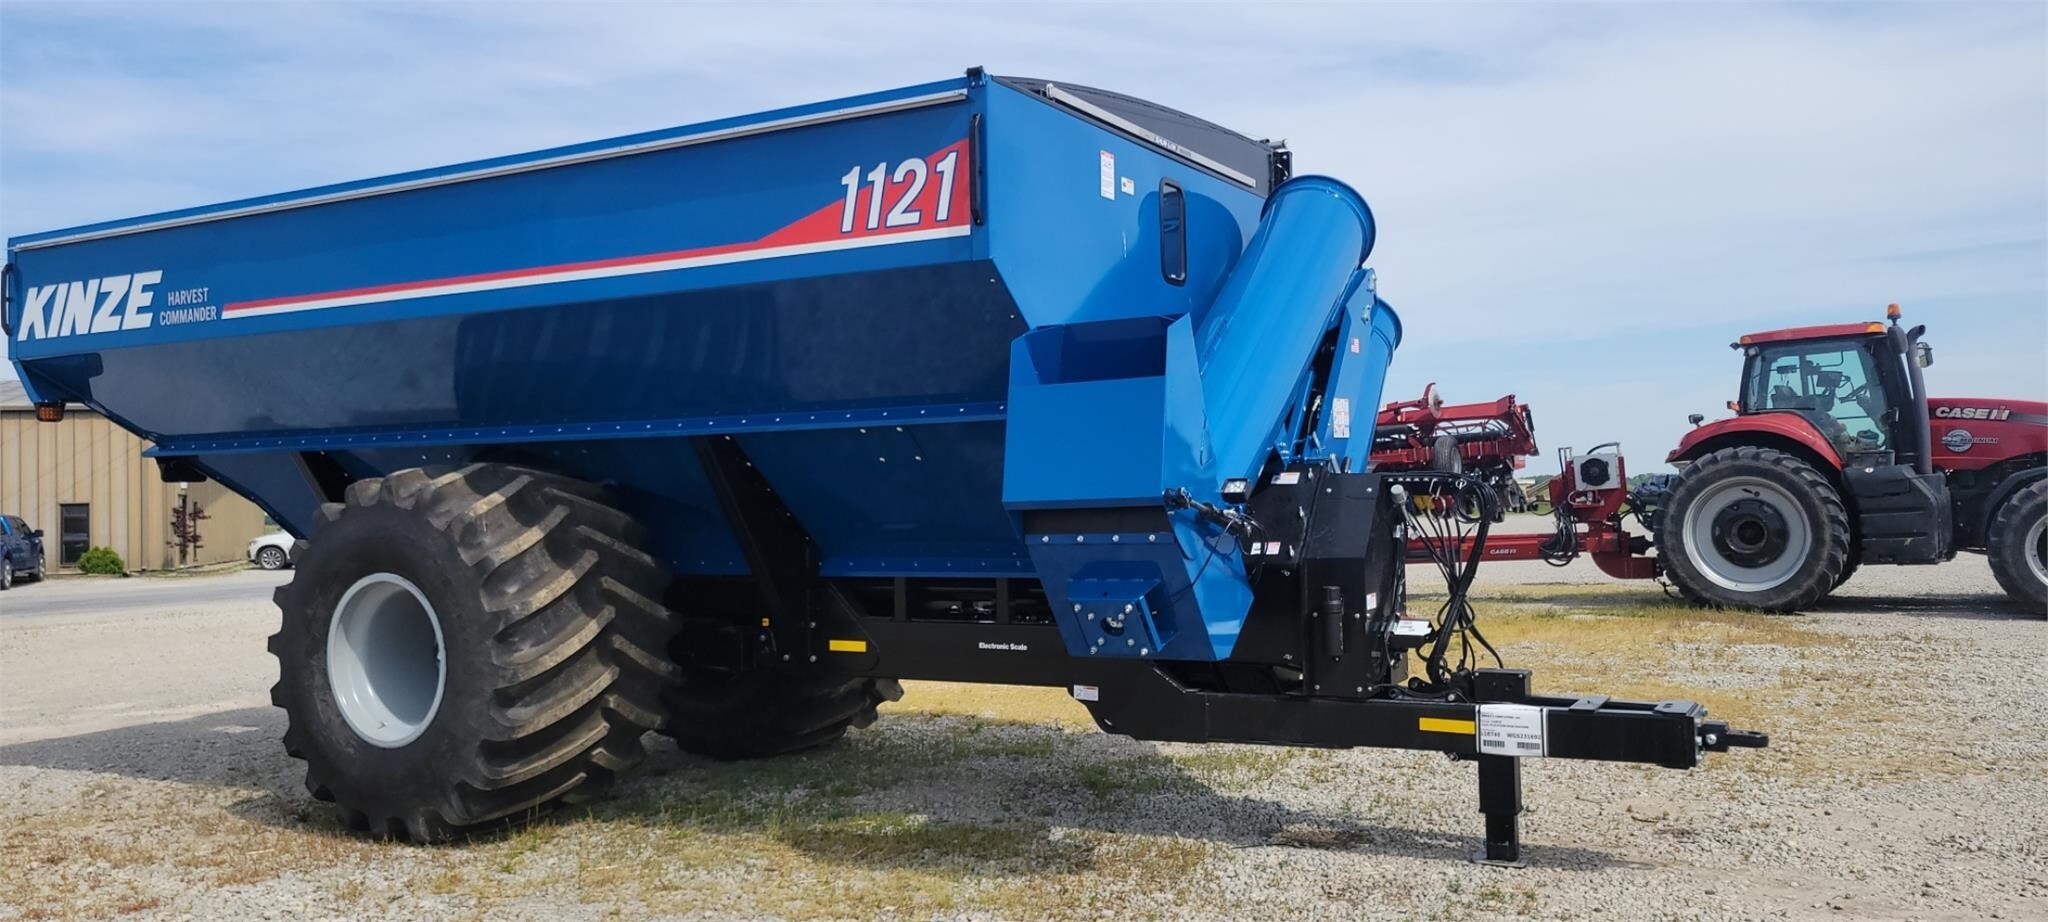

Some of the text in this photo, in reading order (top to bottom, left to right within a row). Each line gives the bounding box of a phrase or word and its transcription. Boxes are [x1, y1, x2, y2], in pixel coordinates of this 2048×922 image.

[840, 151, 958, 233] 1121
[17, 270, 163, 341] KINZE
[168, 288, 209, 306] HARVEST
[159, 306, 217, 326] COMMANDER
[1935, 406, 1990, 419] CASE
[978, 642, 1028, 651] Electronic Scale
